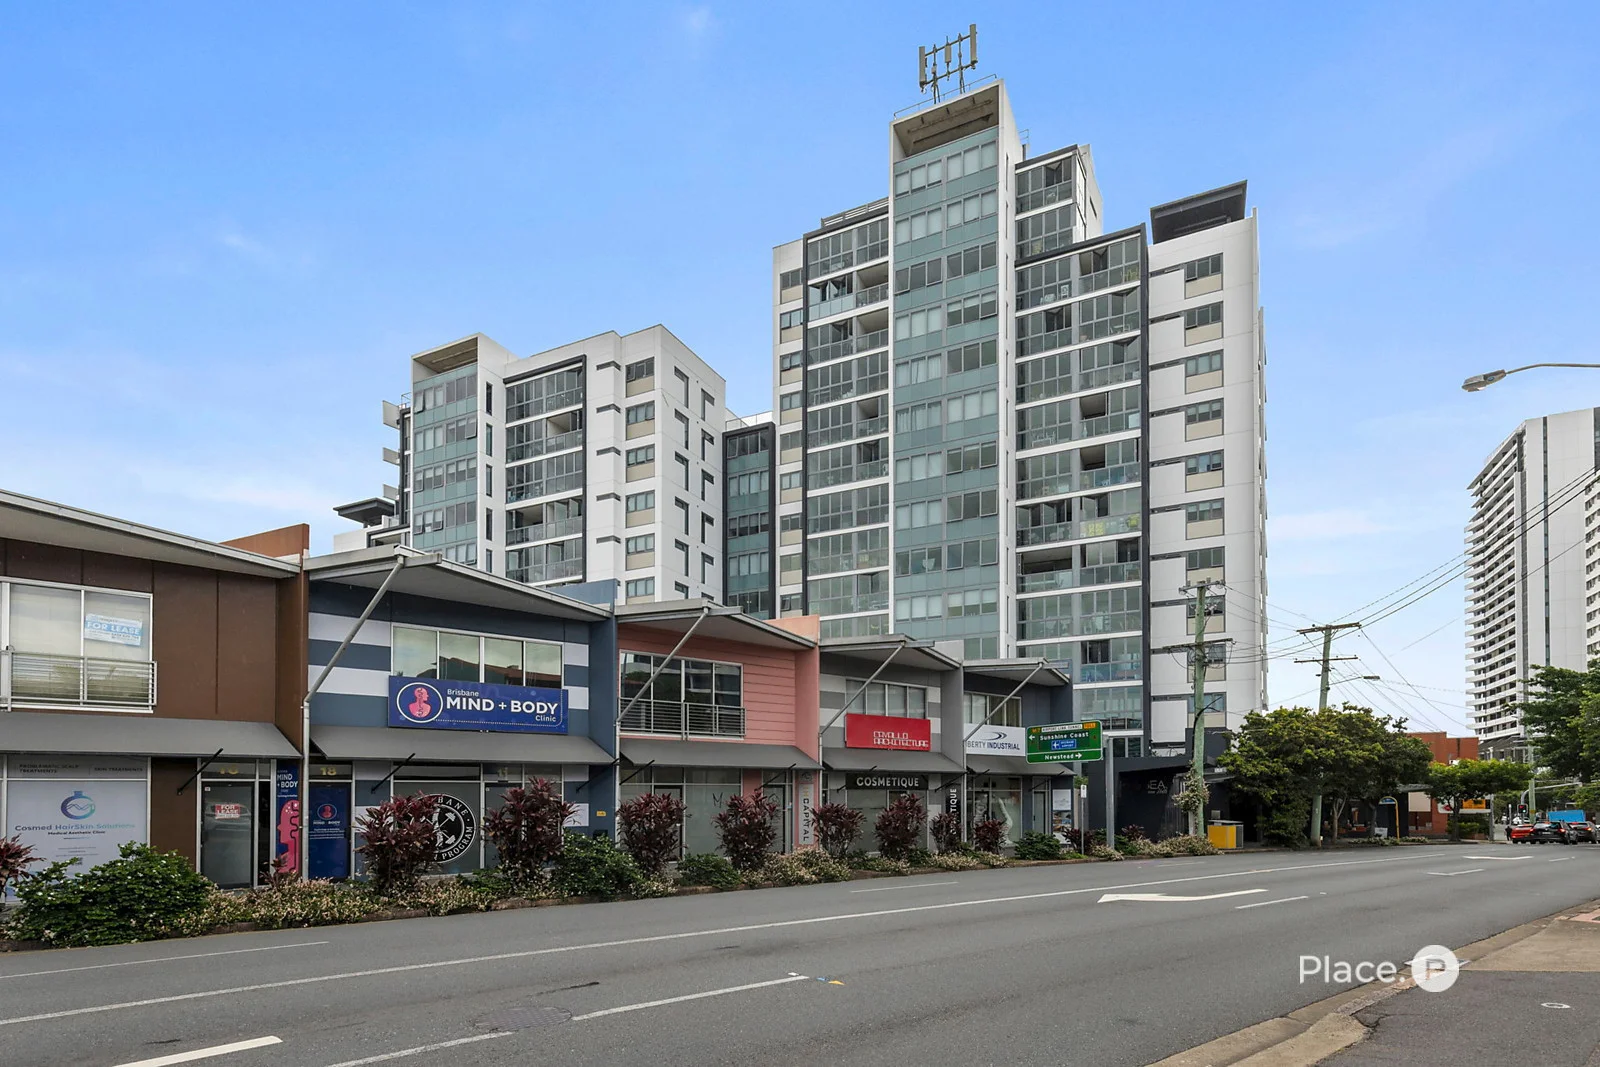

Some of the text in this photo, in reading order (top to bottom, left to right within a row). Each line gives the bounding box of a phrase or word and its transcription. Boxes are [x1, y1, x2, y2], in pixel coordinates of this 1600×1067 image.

[87, 621, 108, 631] FOR
[111, 624, 140, 635] LEASE
[447, 688, 480, 698] Brisbane
[446, 697, 559, 715] MIND + BODY
[535, 715, 557, 723] Clinic
[1040, 733, 1067, 741] Sunshine
[966, 741, 1020, 751] BERTY INDUSTRIAL
[320, 766, 337, 776] 18
[277, 773, 293, 781] MIND
[856, 776, 919, 788] COSMETIQUE
[14, 824, 52, 832] Cosmed
[55, 823, 94, 831] HairSkin
[441, 826, 474, 860] PROGRAM
